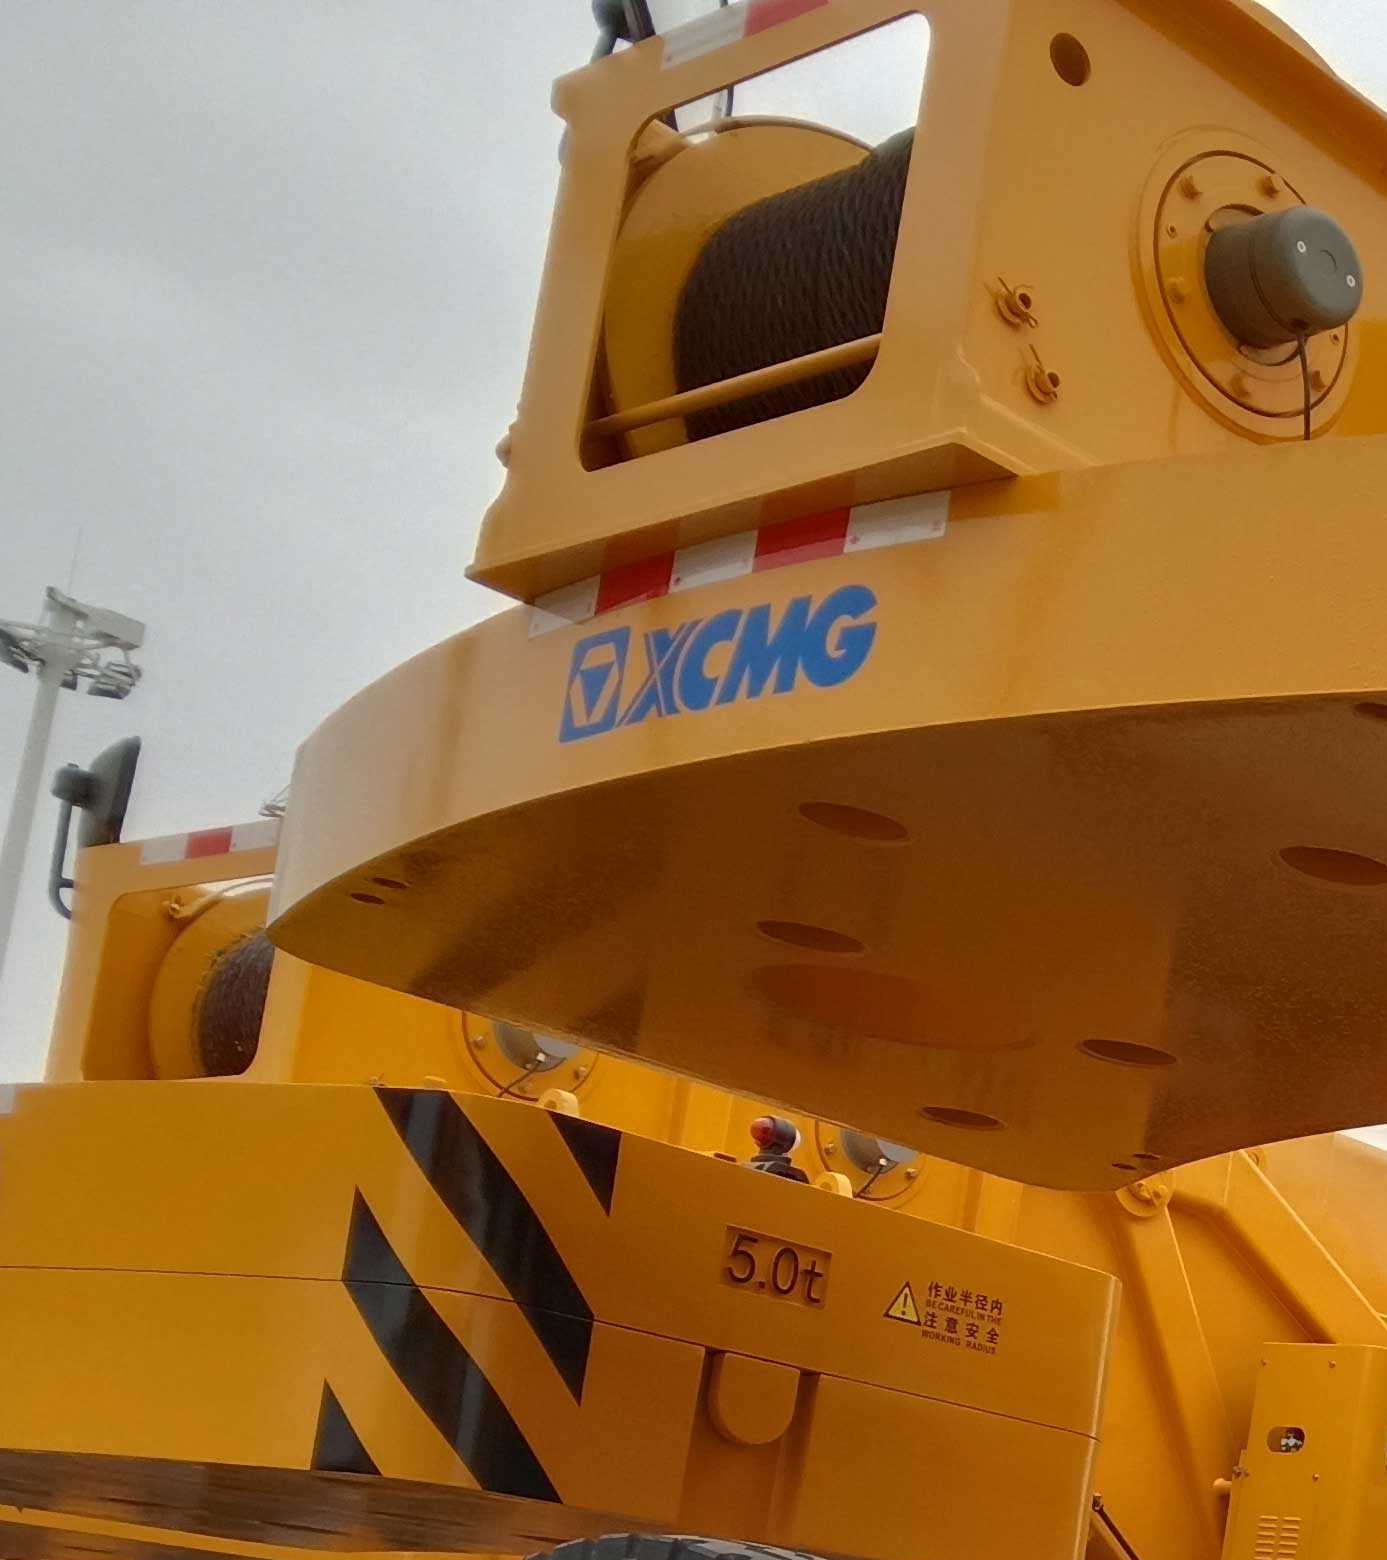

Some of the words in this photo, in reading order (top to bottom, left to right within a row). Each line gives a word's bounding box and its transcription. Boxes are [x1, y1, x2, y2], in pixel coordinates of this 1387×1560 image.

[614, 584, 878, 728] XCMG
[727, 1233, 824, 1304] 5.0t
[926, 1299, 937, 1309] BE
[938, 1302, 976, 1320] CAREFUL
[976, 1312, 985, 1322] IN
[987, 1315, 1002, 1326] THE
[928, 1280, 1003, 1316] 作业半径内
[922, 1329, 961, 1346] WORKING
[966, 1340, 996, 1355] RADIUS
[924, 1311, 1000, 1345] 注意安全
